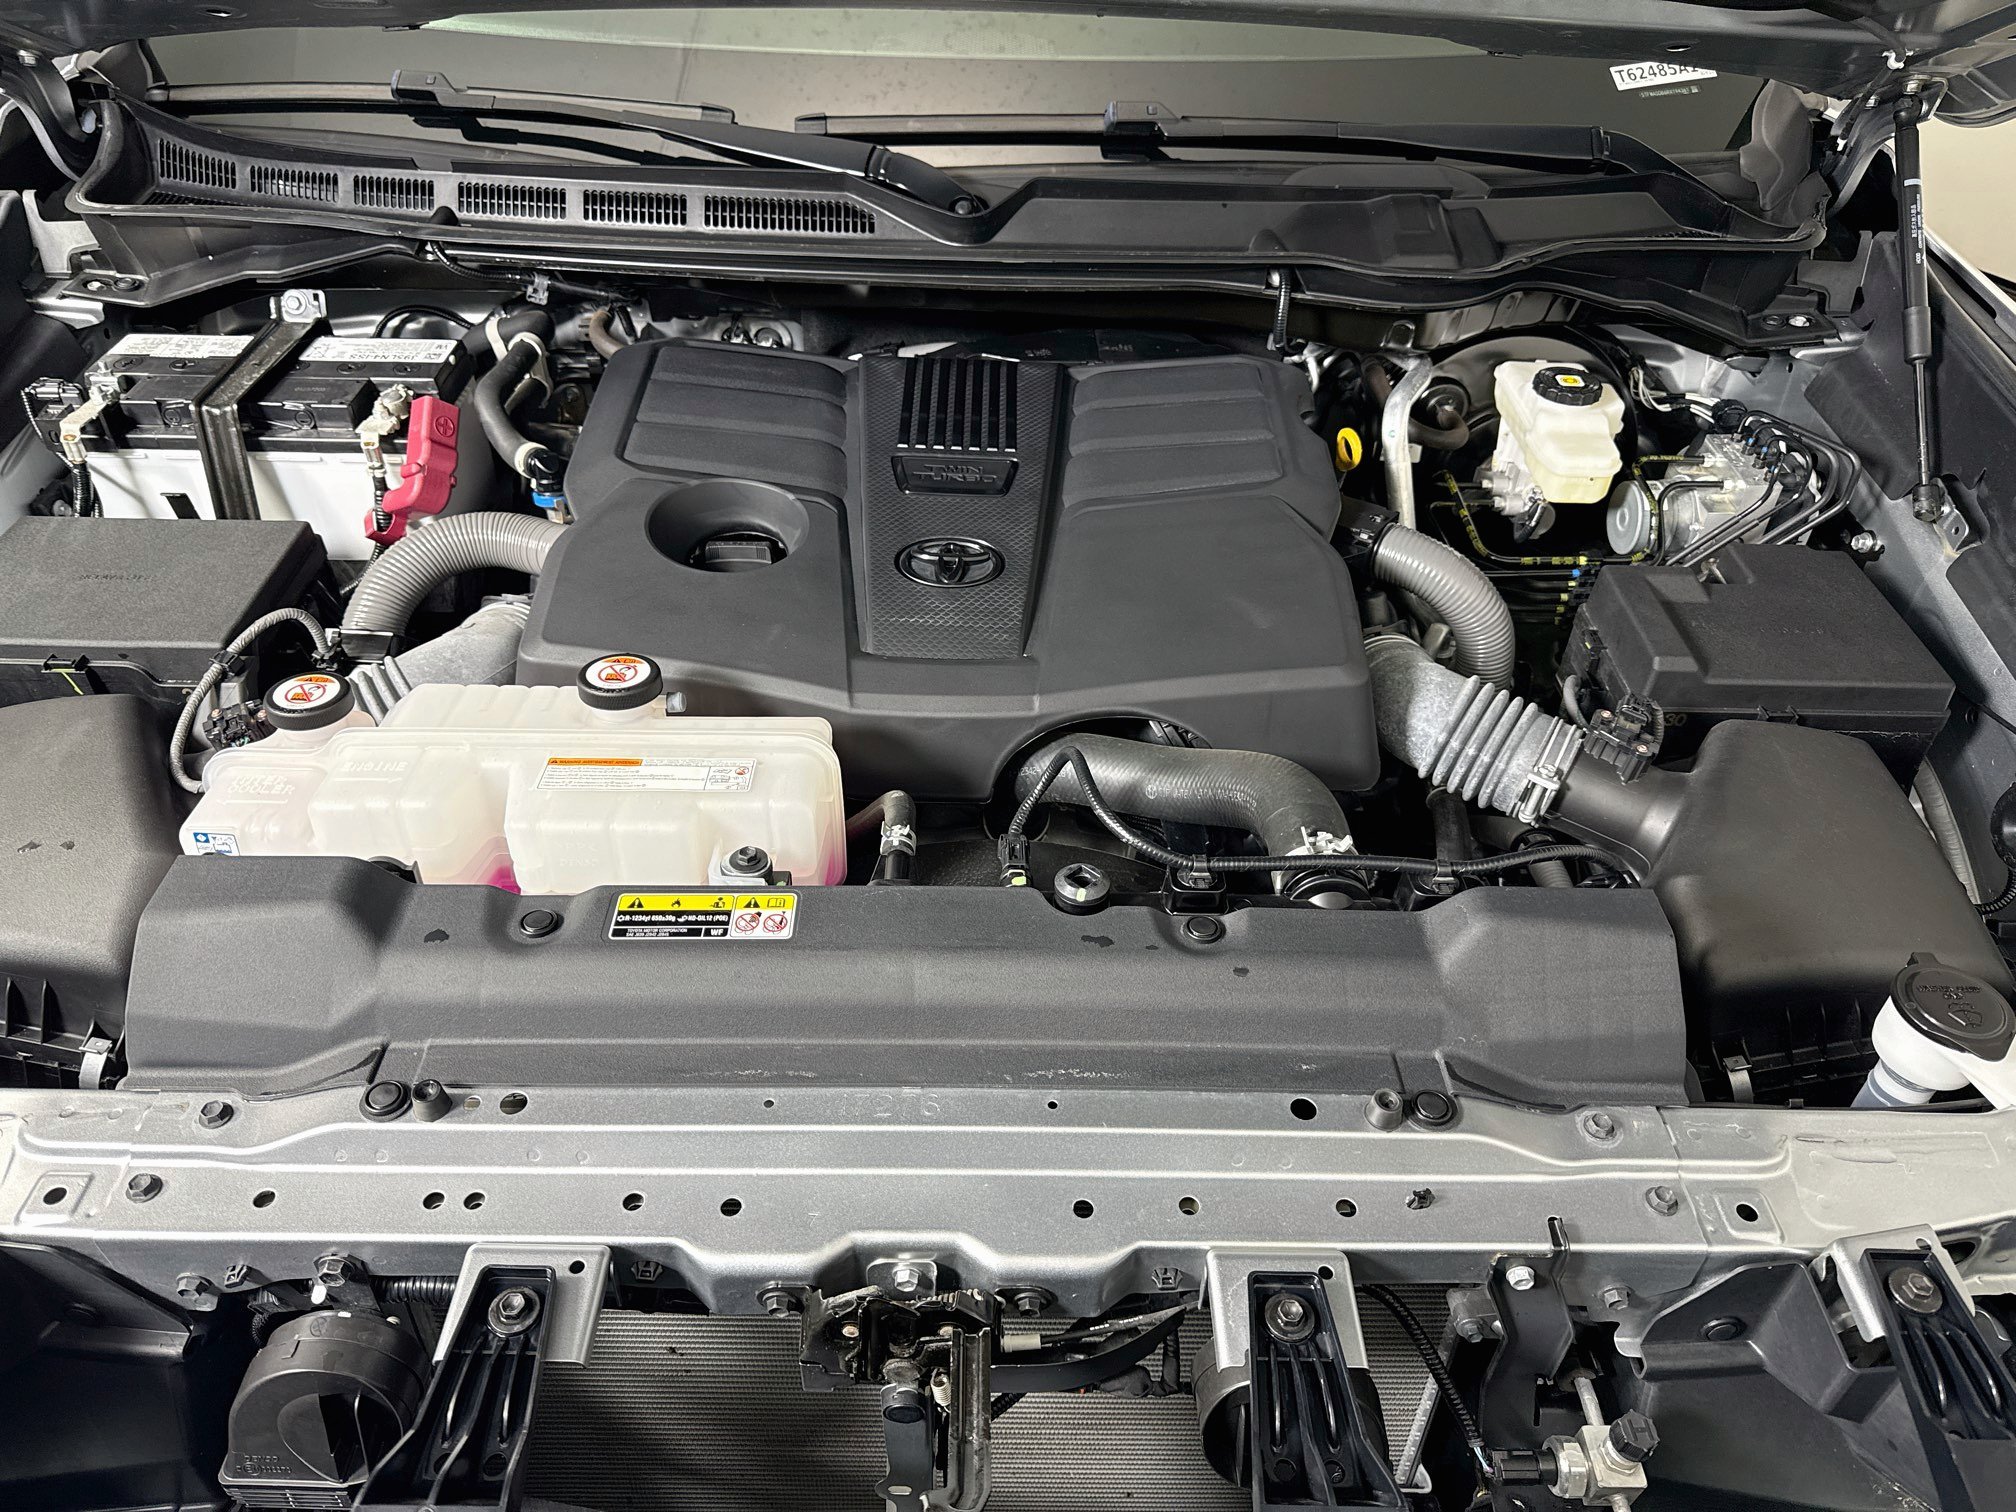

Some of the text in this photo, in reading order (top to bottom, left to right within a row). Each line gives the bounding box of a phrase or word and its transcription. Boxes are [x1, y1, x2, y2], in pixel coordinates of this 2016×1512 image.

[924, 463, 983, 474] TWIN
[913, 471, 997, 483] TURBO
[343, 761, 408, 772] ENGINE
[710, 928, 724, 936] WF
